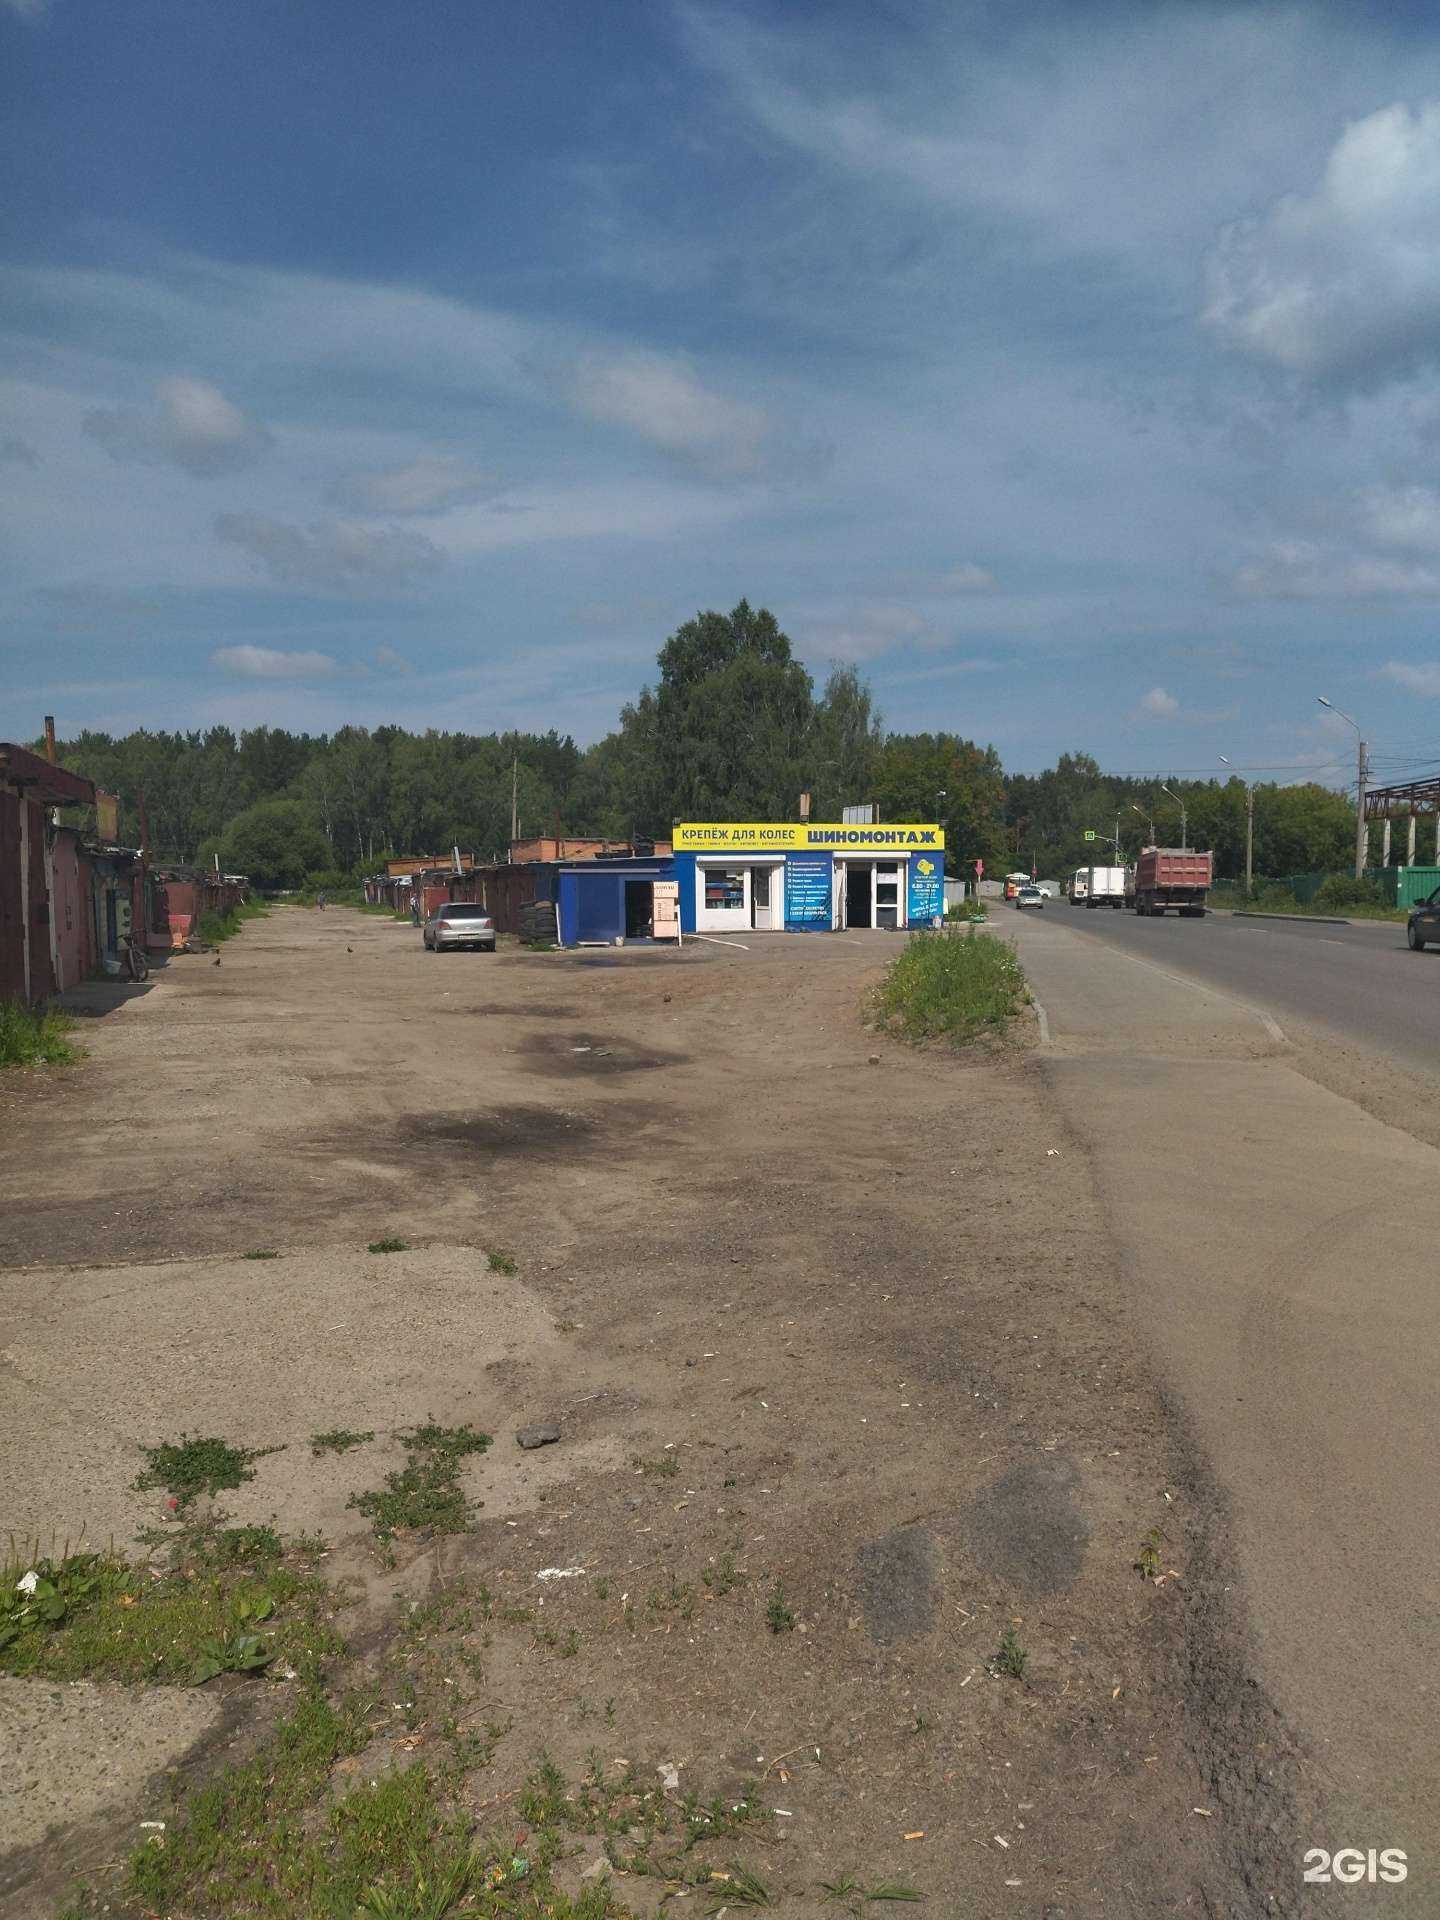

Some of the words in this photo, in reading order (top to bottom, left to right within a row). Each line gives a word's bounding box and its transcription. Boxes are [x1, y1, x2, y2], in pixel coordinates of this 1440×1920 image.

[682, 828, 728, 840] КРЕПЁЖ
[732, 829, 755, 841] ДЛЯ
[760, 829, 795, 840] КОЛЕС
[808, 830, 936, 844] ШИНОМОНТАЖ
